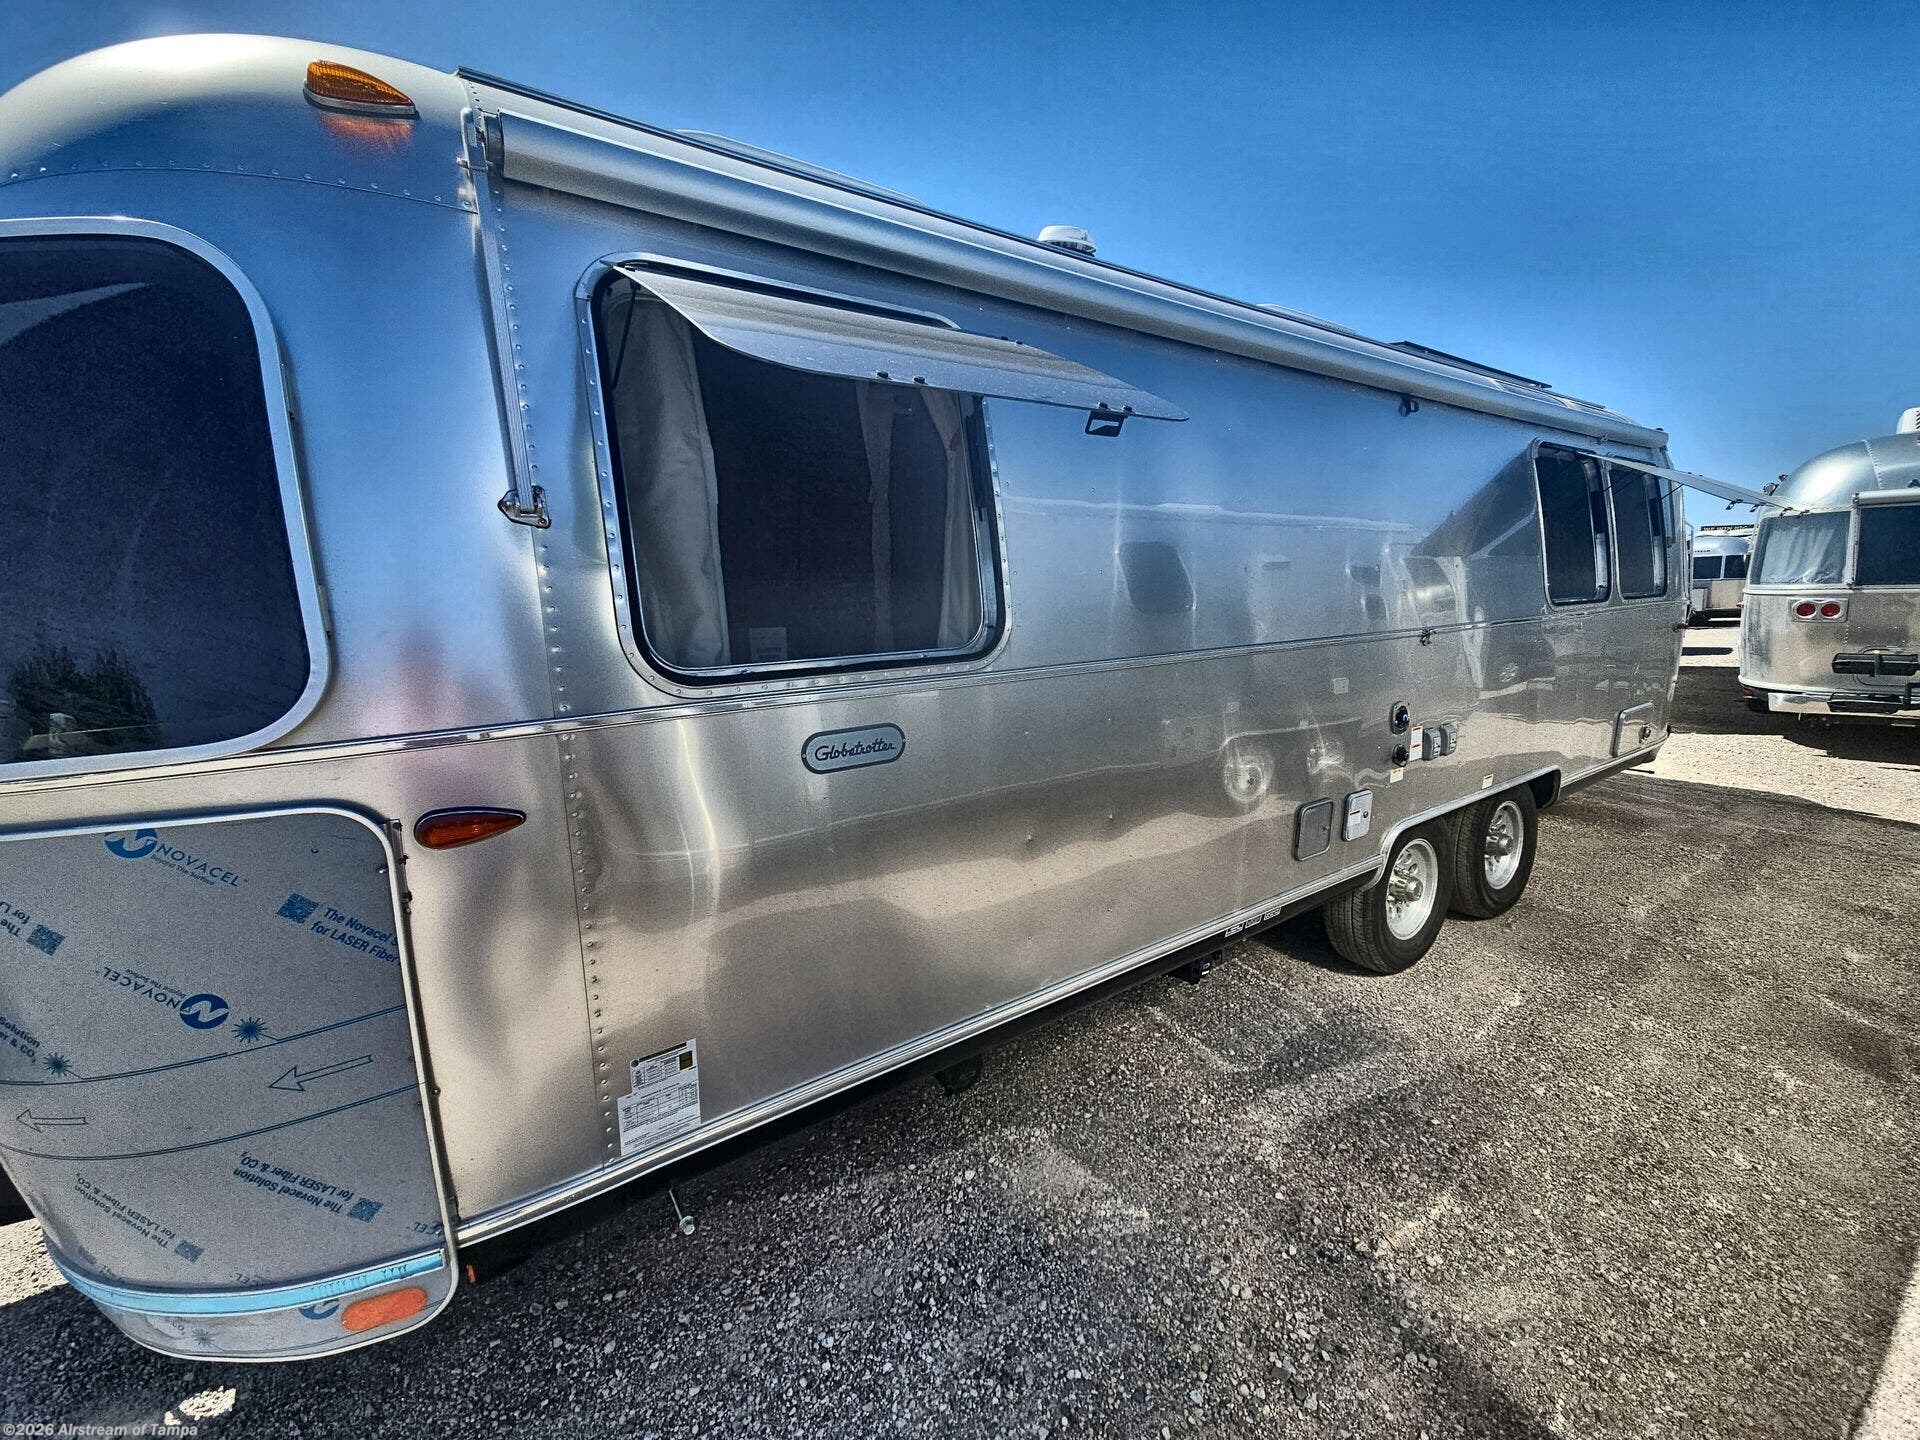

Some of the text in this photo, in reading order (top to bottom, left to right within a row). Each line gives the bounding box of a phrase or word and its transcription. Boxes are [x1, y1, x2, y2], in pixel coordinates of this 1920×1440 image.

[814, 738, 897, 761] Globetrotter
[156, 843, 239, 887] NOVACEL
[11, 909, 31, 925] for
[324, 907, 345, 924] The
[345, 917, 393, 943] Novacel
[1, 918, 20, 938] The
[311, 920, 398, 963] for LASER Fiber
[103, 966, 180, 1009] NOVACEL
[0, 1016, 40, 1048] Solution
[10, 1038, 18, 1047] &
[260, 1162, 270, 1173] &
[270, 1166, 300, 1183] Fiber
[233, 1167, 343, 1214] The Novacel Solution
[299, 1176, 338, 1196] LASER
[336, 1189, 355, 1201] for
[102, 1193, 127, 1212] Fiber
[74, 1184, 169, 1249] The Novacel Solution
[127, 1208, 160, 1232] LASER
[160, 1227, 176, 1240] for
